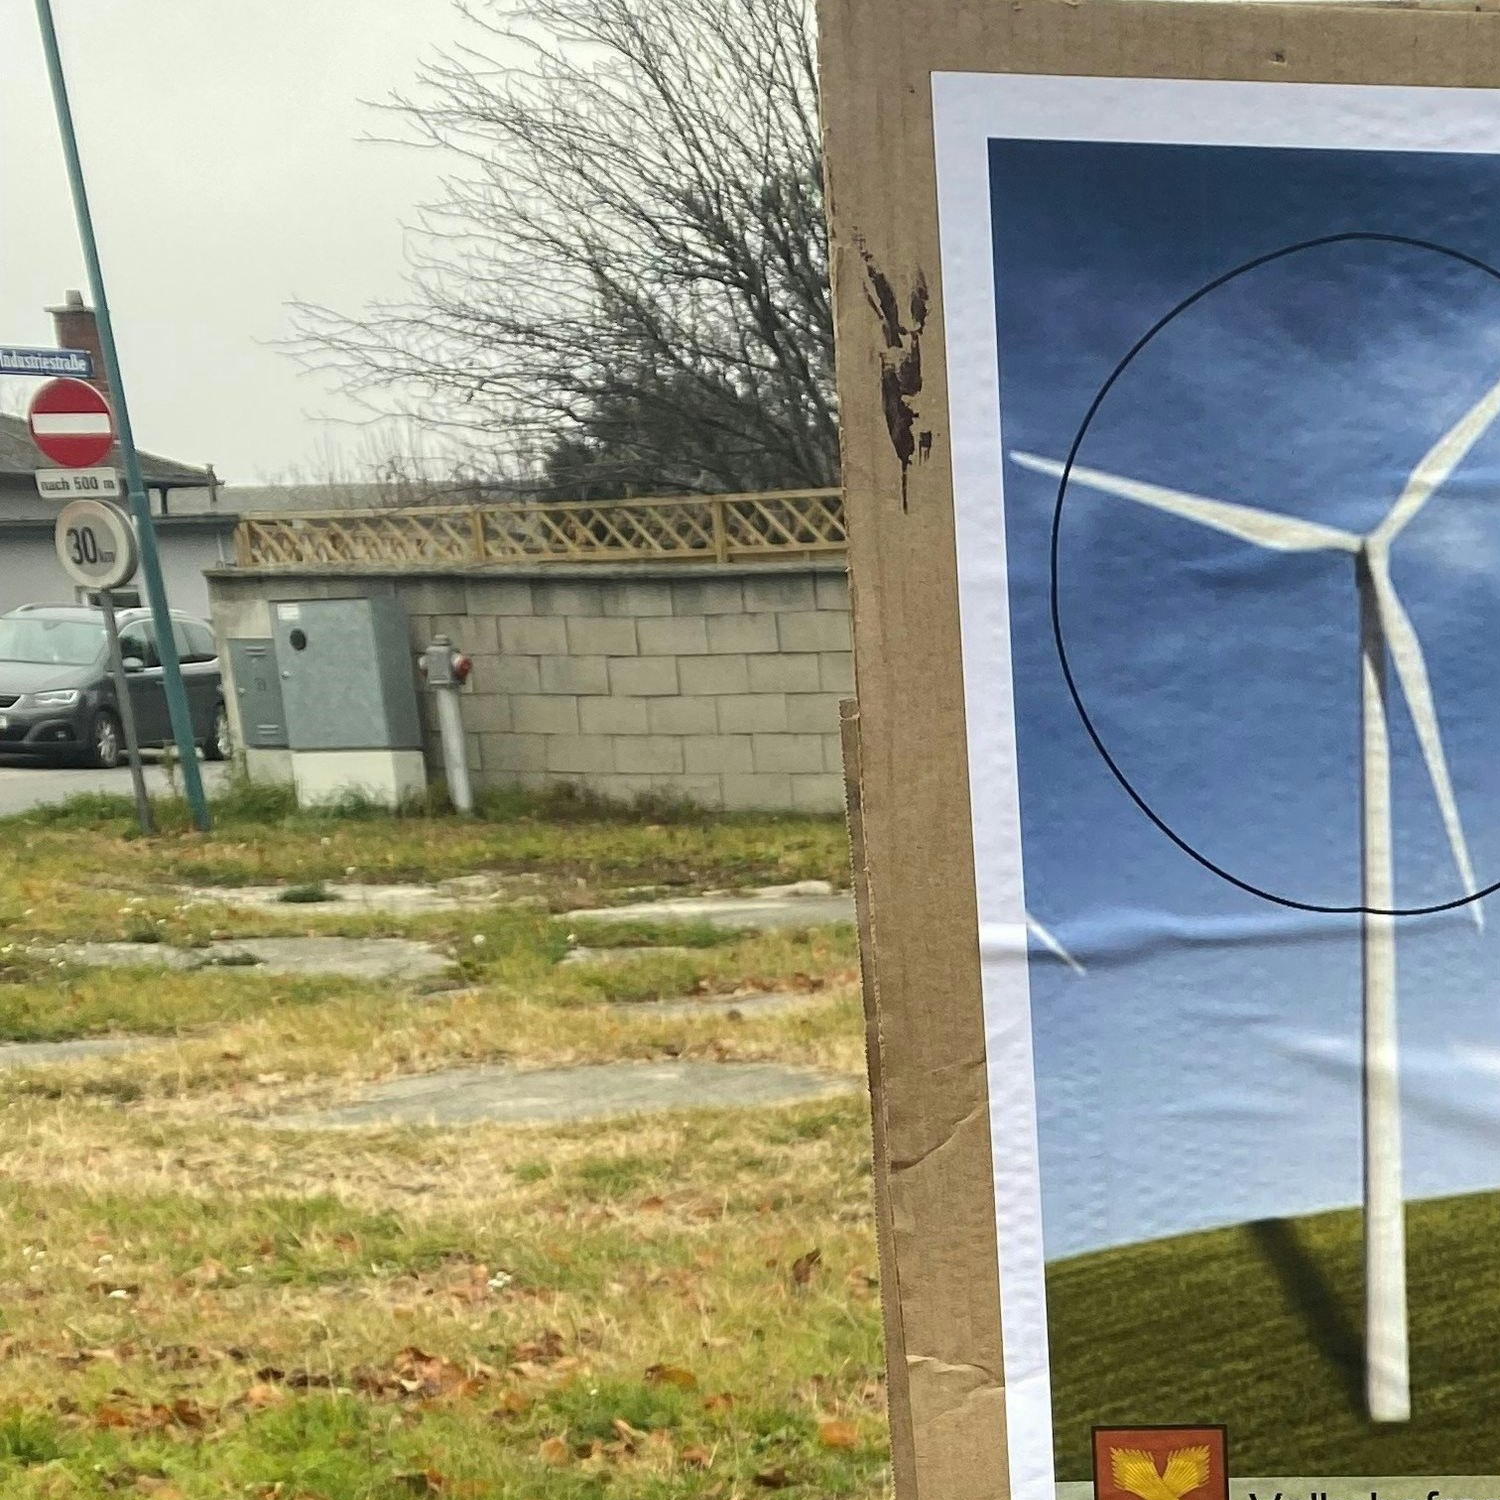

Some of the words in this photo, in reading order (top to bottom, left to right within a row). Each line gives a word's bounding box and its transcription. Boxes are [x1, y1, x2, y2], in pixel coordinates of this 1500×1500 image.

[41, 477, 70, 491] nach
[73, 476, 99, 490] 500
[103, 479, 115, 489] m
[66, 526, 98, 565] 30
